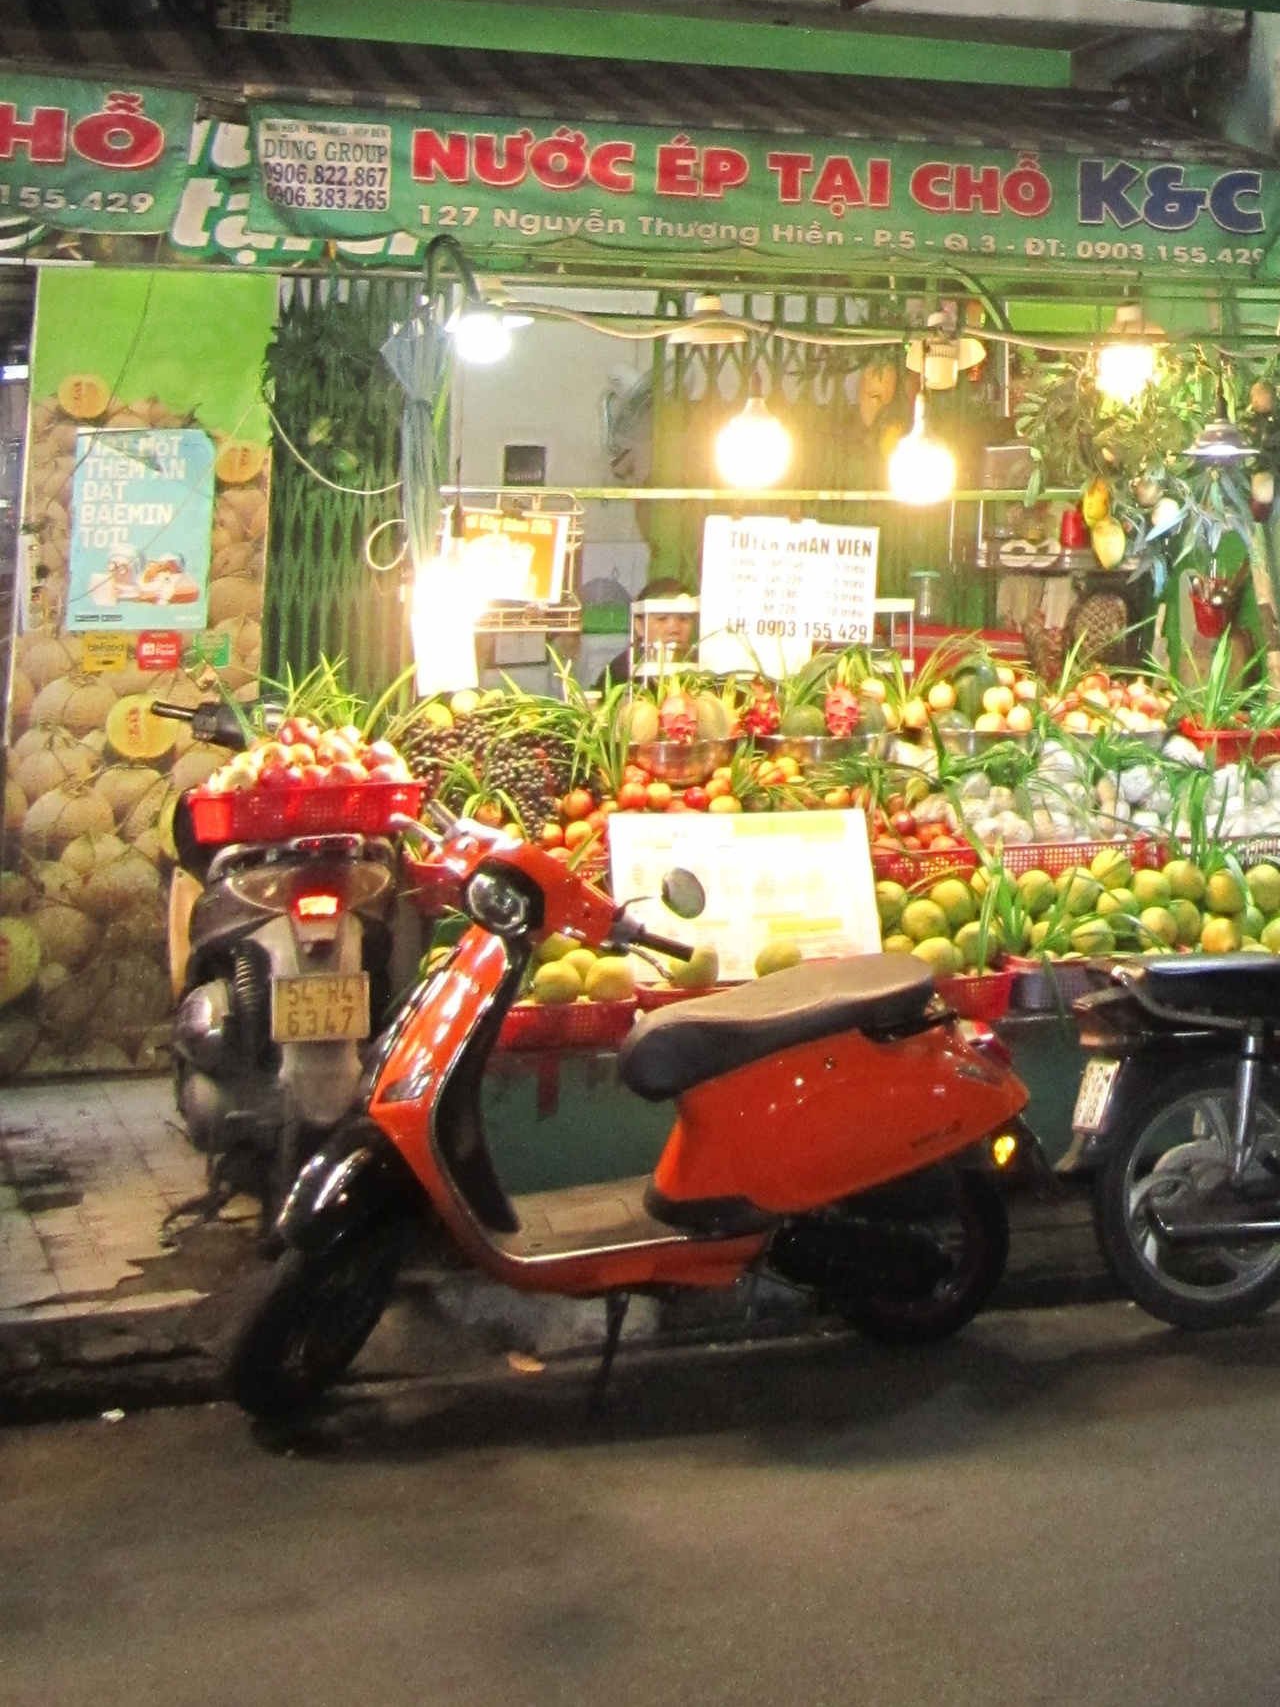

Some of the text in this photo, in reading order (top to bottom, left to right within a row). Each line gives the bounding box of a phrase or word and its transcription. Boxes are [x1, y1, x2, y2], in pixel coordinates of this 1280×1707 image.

[263, 134, 318, 161] DŨNG
[325, 141, 388, 164] GROUP
[263, 162, 389, 188] 0906.822.867
[411, 126, 1267, 235] NƯỚC ÉP TẠI CHỖ K&C
[418, 204, 480, 229] 127
[493, 206, 628, 237] Nguyễn
[638, 215, 761, 248] Thượng
[772, 218, 845, 247] Hiền
[874, 229, 916, 251] P.5
[944, 232, 997, 255] Q.3
[1025, 238, 1067, 259] ĐT:
[80, 502, 174, 526] BAEMIN
[756, 619, 797, 638] 0903
[804, 621, 832, 640] 155
[838, 624, 868, 642] 429
